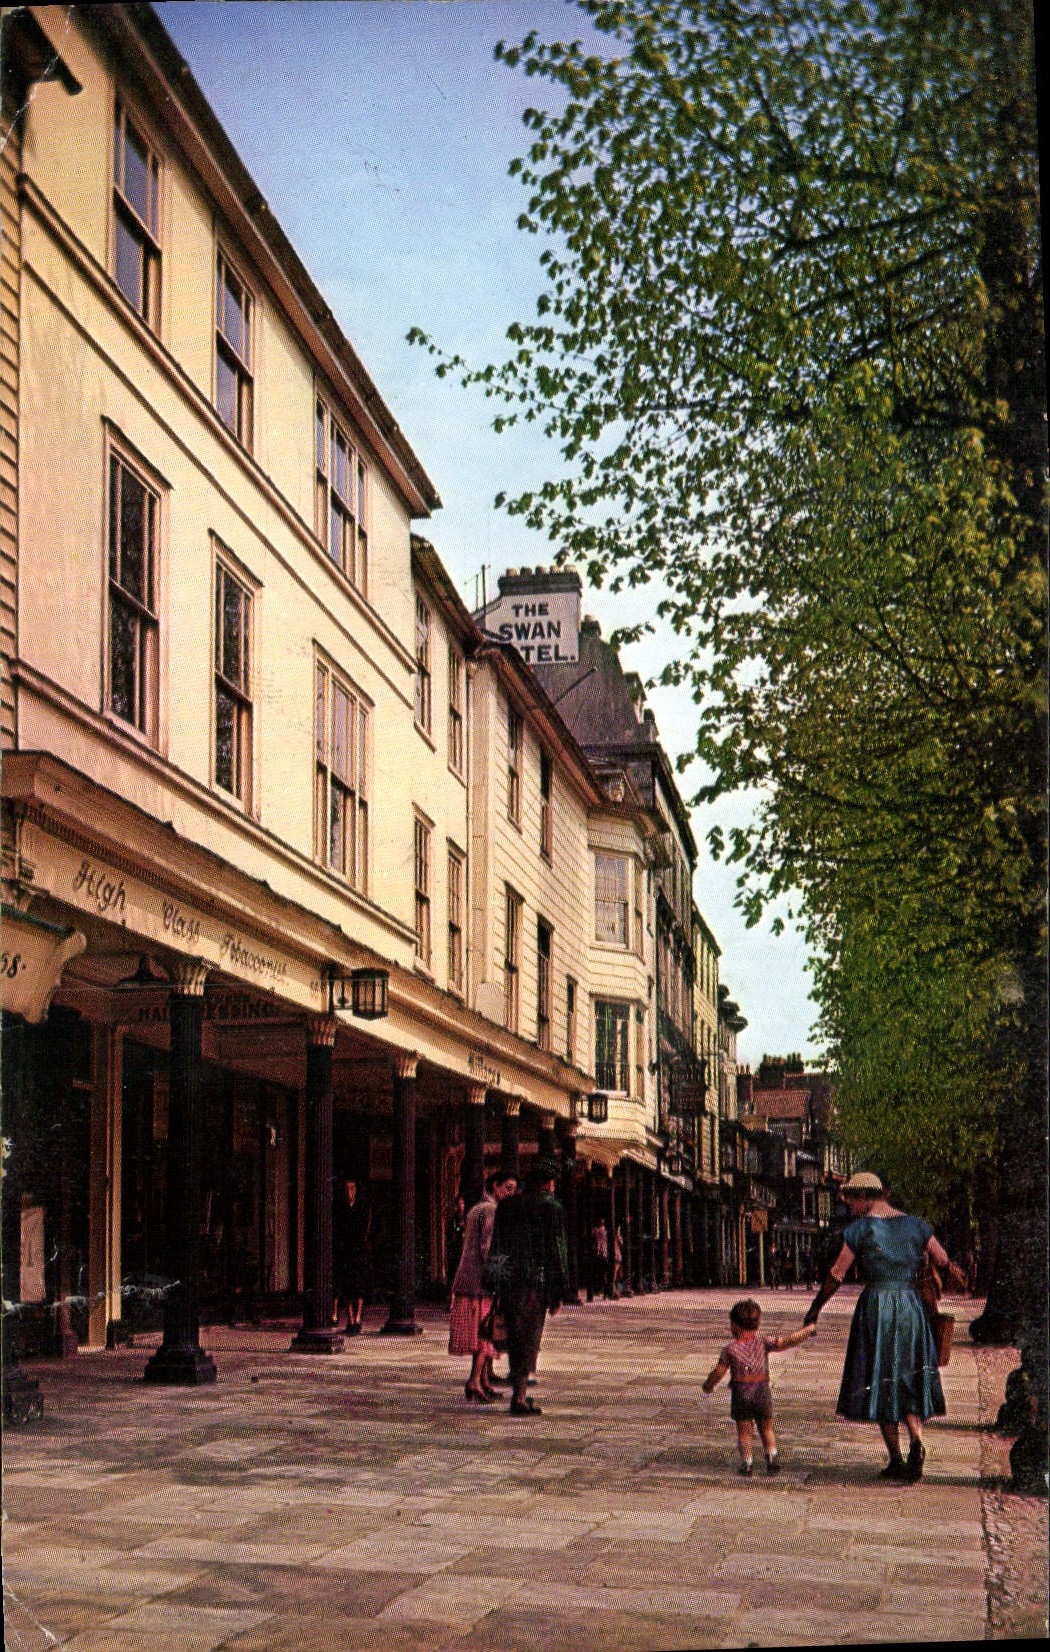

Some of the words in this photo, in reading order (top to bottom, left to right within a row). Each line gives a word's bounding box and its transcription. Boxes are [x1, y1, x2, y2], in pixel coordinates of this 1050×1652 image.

[511, 603, 549, 617] THE
[499, 620, 561, 641] SWAN
[520, 645, 576, 662] TEL.
[73, 861, 126, 913] High
[161, 901, 201, 945] Class
